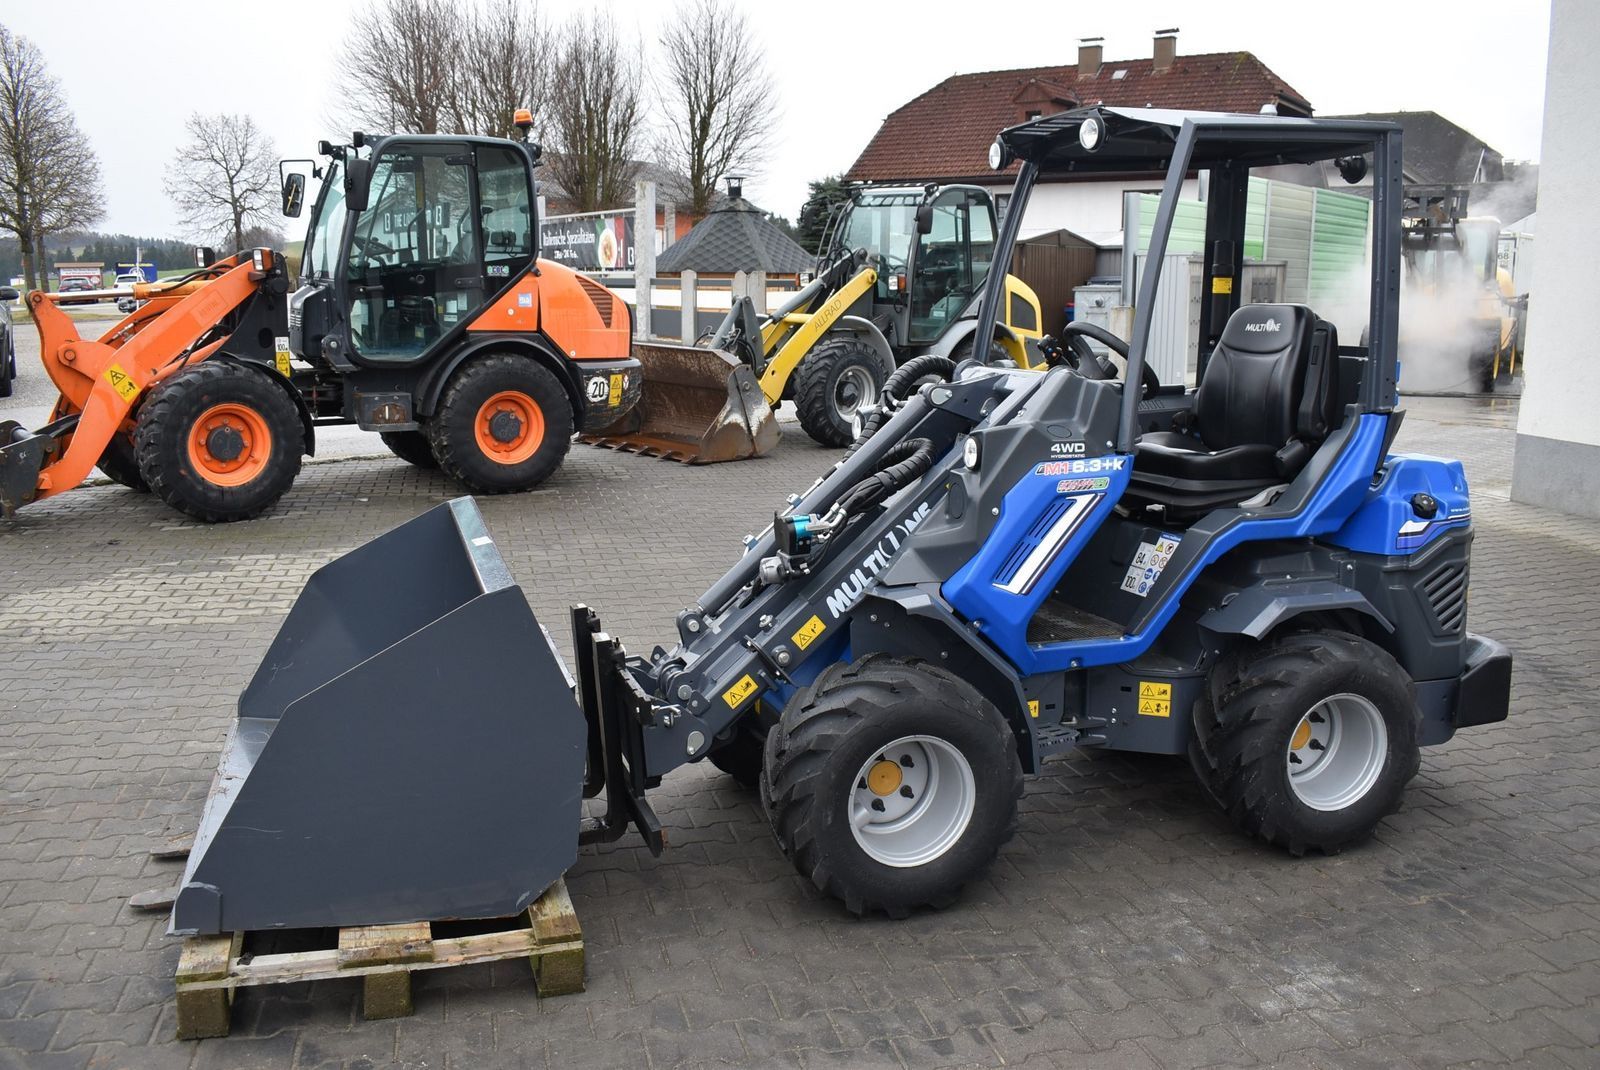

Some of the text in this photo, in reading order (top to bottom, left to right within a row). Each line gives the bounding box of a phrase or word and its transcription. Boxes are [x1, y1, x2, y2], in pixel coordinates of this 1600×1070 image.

[814, 299, 842, 332] ALLRAD
[1245, 318, 1281, 332] MULTIONE
[591, 381, 605, 398] 20
[1050, 442, 1086, 453] 4WD
[1072, 458, 1126, 473] 6.3+k
